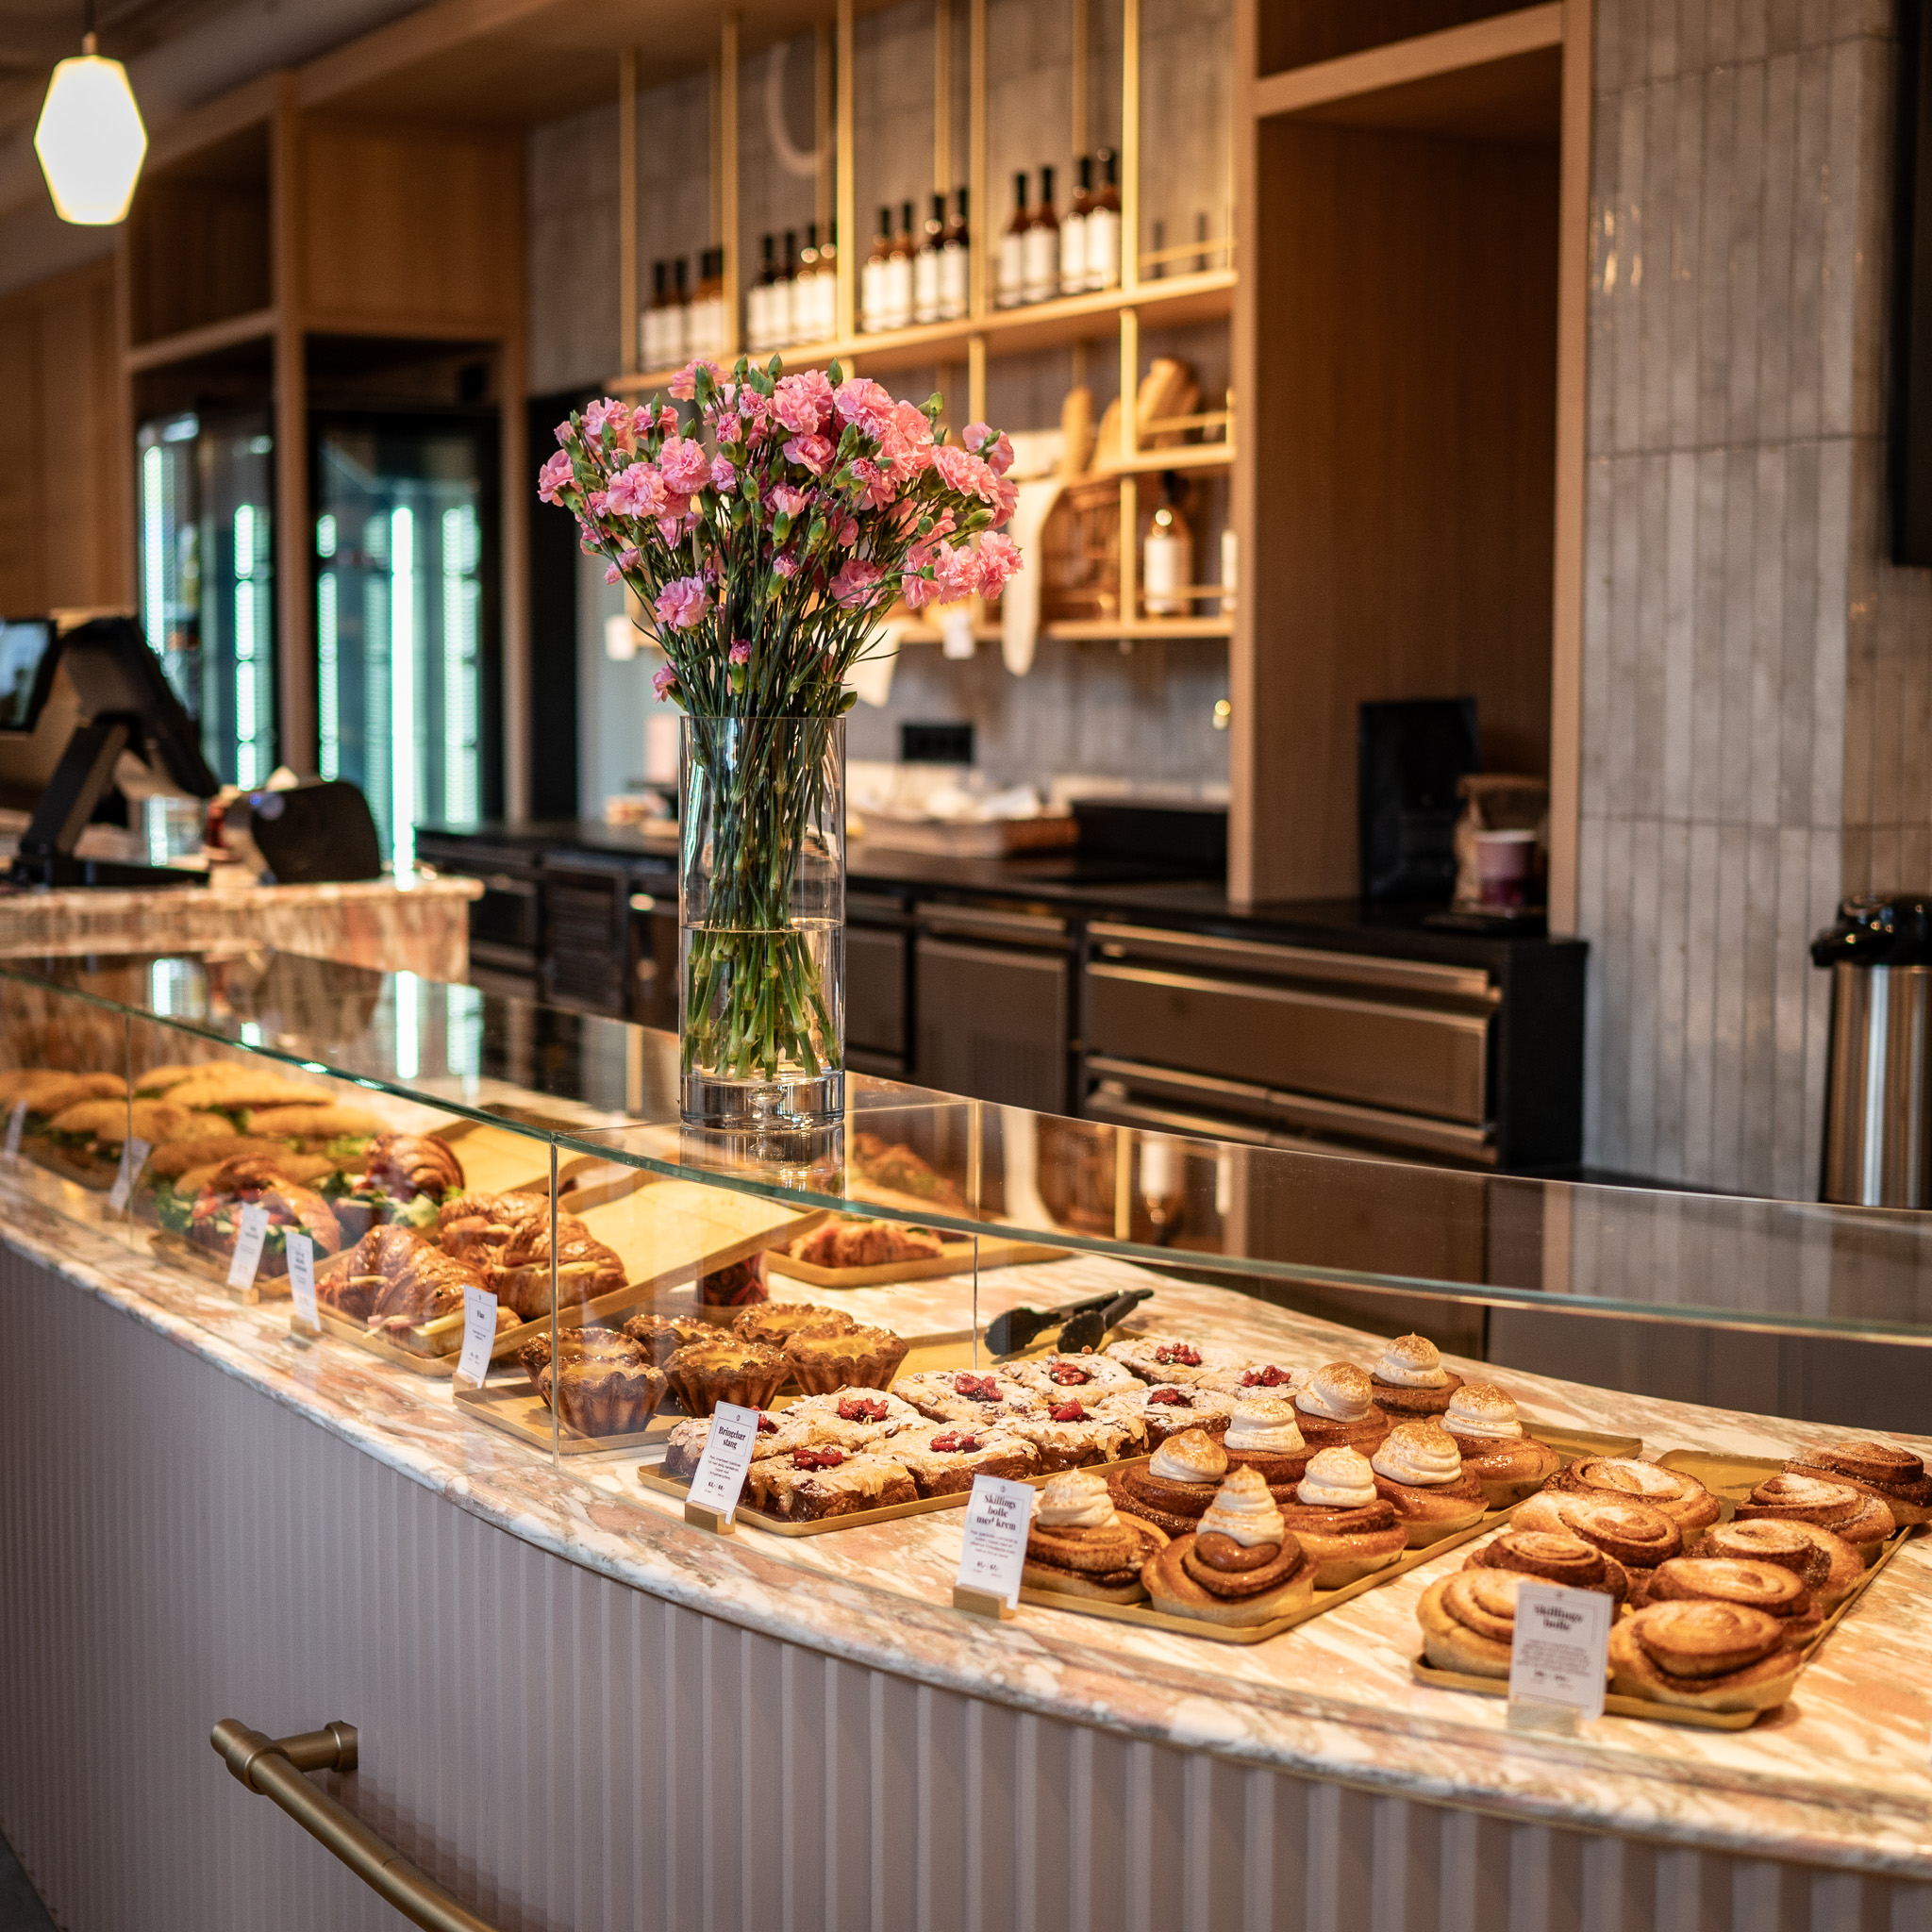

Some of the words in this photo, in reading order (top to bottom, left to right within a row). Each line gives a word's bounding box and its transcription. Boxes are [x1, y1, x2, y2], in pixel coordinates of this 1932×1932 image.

[723, 1439, 738, 1450] stang
[983, 1494, 1017, 1509] Skillings
[987, 1506, 1008, 1518] bolle
[995, 1518, 1016, 1531] krem
